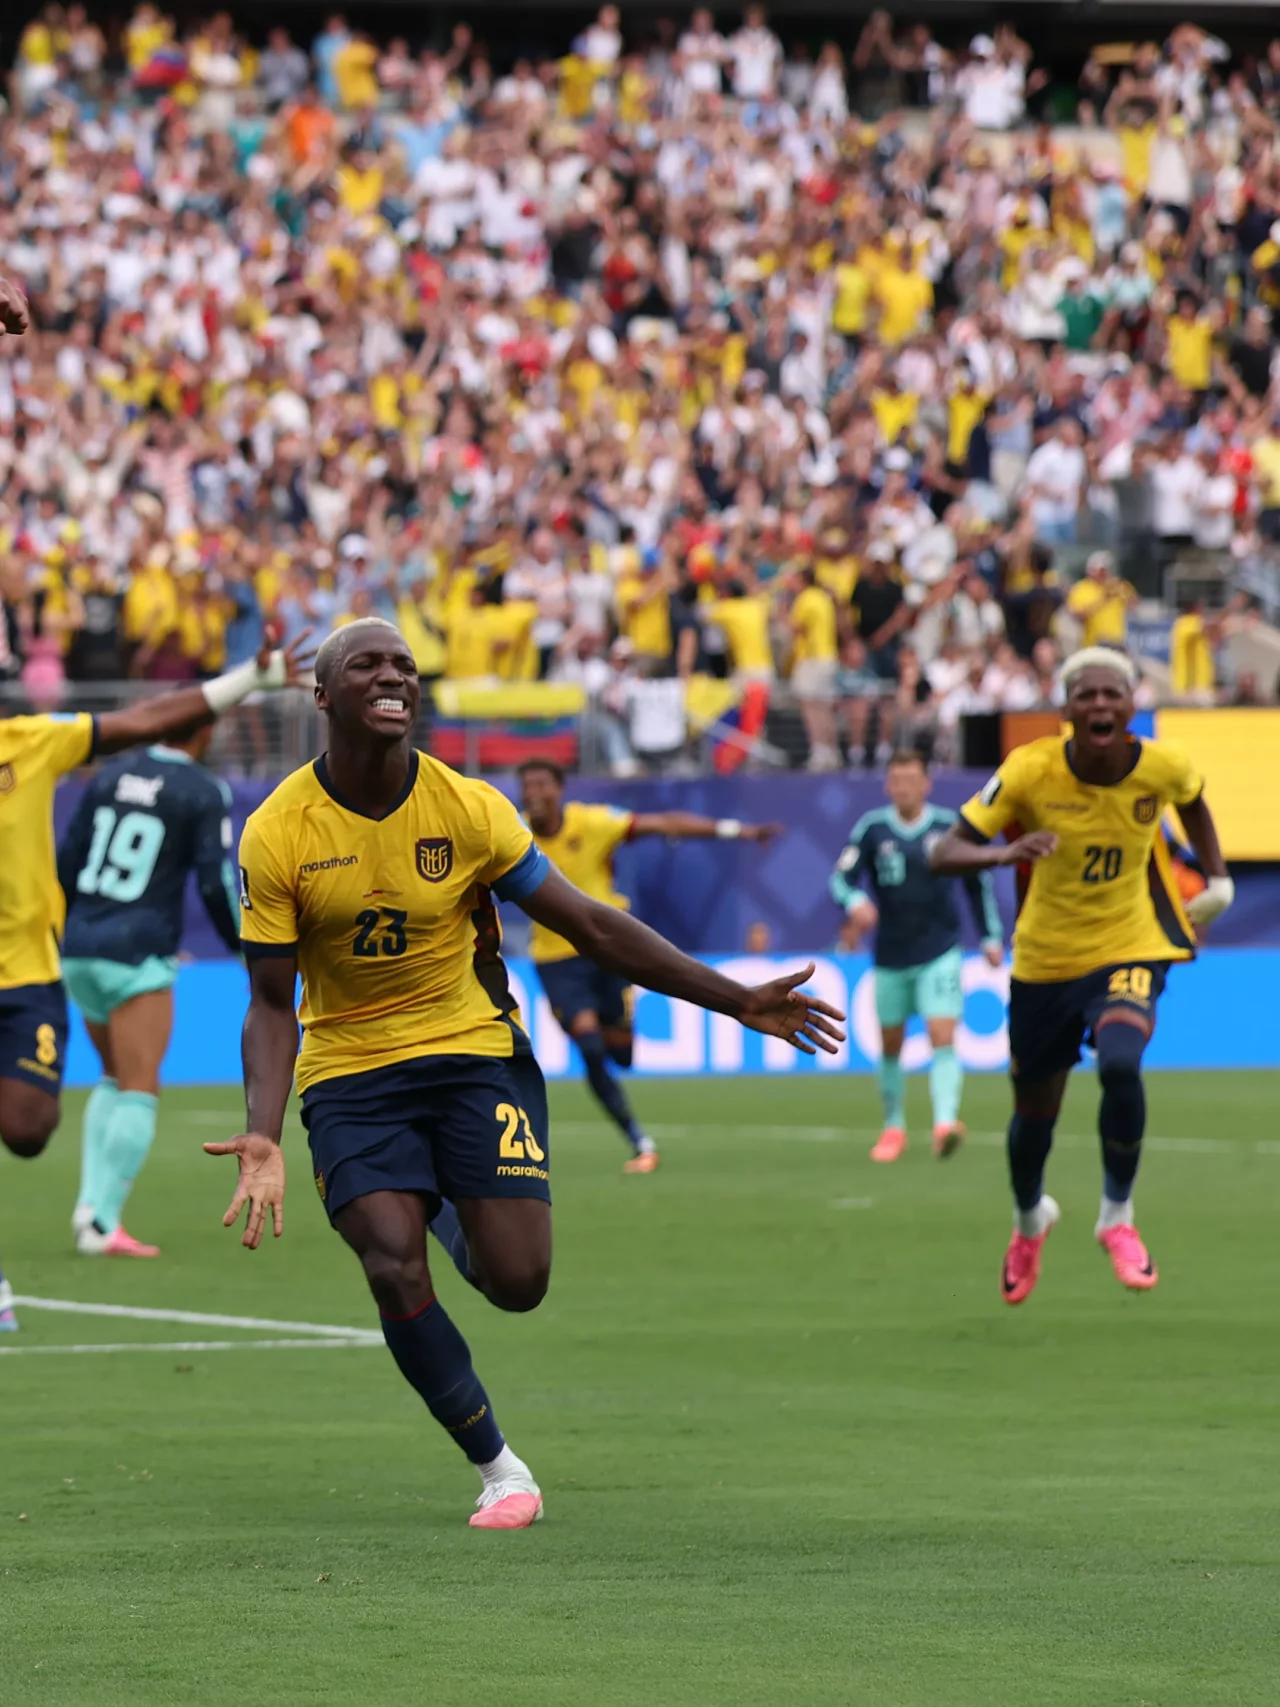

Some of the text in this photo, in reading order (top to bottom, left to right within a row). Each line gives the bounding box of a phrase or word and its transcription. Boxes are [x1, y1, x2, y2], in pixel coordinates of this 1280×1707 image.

[76, 805, 167, 903] 19
[299, 854, 358, 875] marathon
[1081, 846, 1123, 885] 20
[353, 908, 408, 957] 23
[495, 1102, 545, 1163] 23
